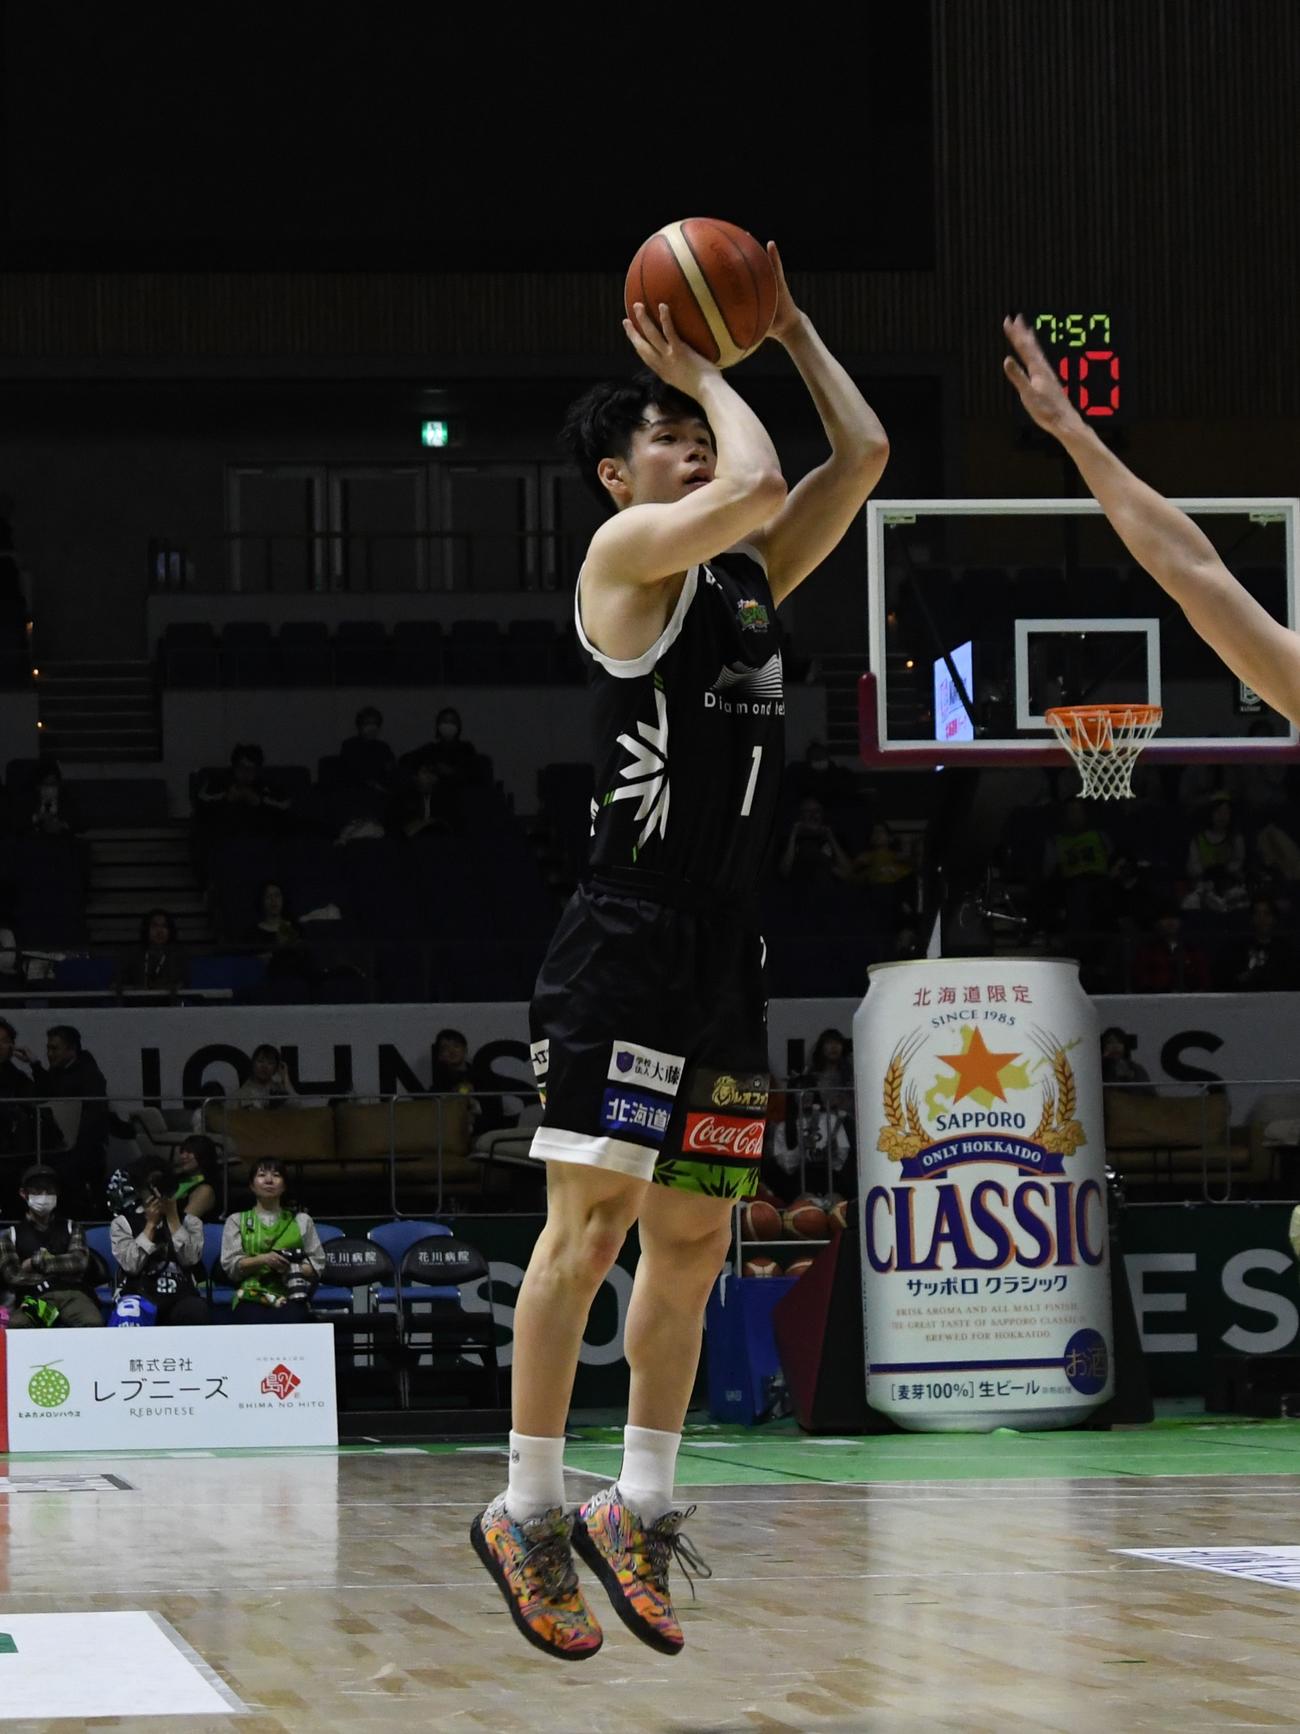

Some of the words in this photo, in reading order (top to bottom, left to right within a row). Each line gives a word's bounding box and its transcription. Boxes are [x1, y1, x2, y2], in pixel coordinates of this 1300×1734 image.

[1036, 314, 1110, 347] 7:57
[1059, 351, 1120, 416] 10
[704, 691, 772, 716] Diamond
[740, 745, 763, 817] 1
[912, 984, 1033, 1007] 北海道限定
[931, 1010, 979, 1029] SINCE
[983, 1010, 1016, 1027] 1985
[606, 1098, 671, 1132] 北海道
[936, 1112, 1026, 1132] SAPPORO
[922, 1142, 959, 1167] ONLY
[962, 1140, 1042, 1163] HOKKAIDO
[865, 1179, 1105, 1274] CLASSIC
[906, 1277, 979, 1297] サッポロ
[985, 1274, 1068, 1295] クラシック
[129, 1358, 193, 1373] 株式会社
[94, 1376, 229, 1402] レブニーズ
[891, 1382, 975, 1401] [麦芽100%]
[979, 1379, 1040, 1398] 生ビール
[298, 1400, 326, 1408] HITO
